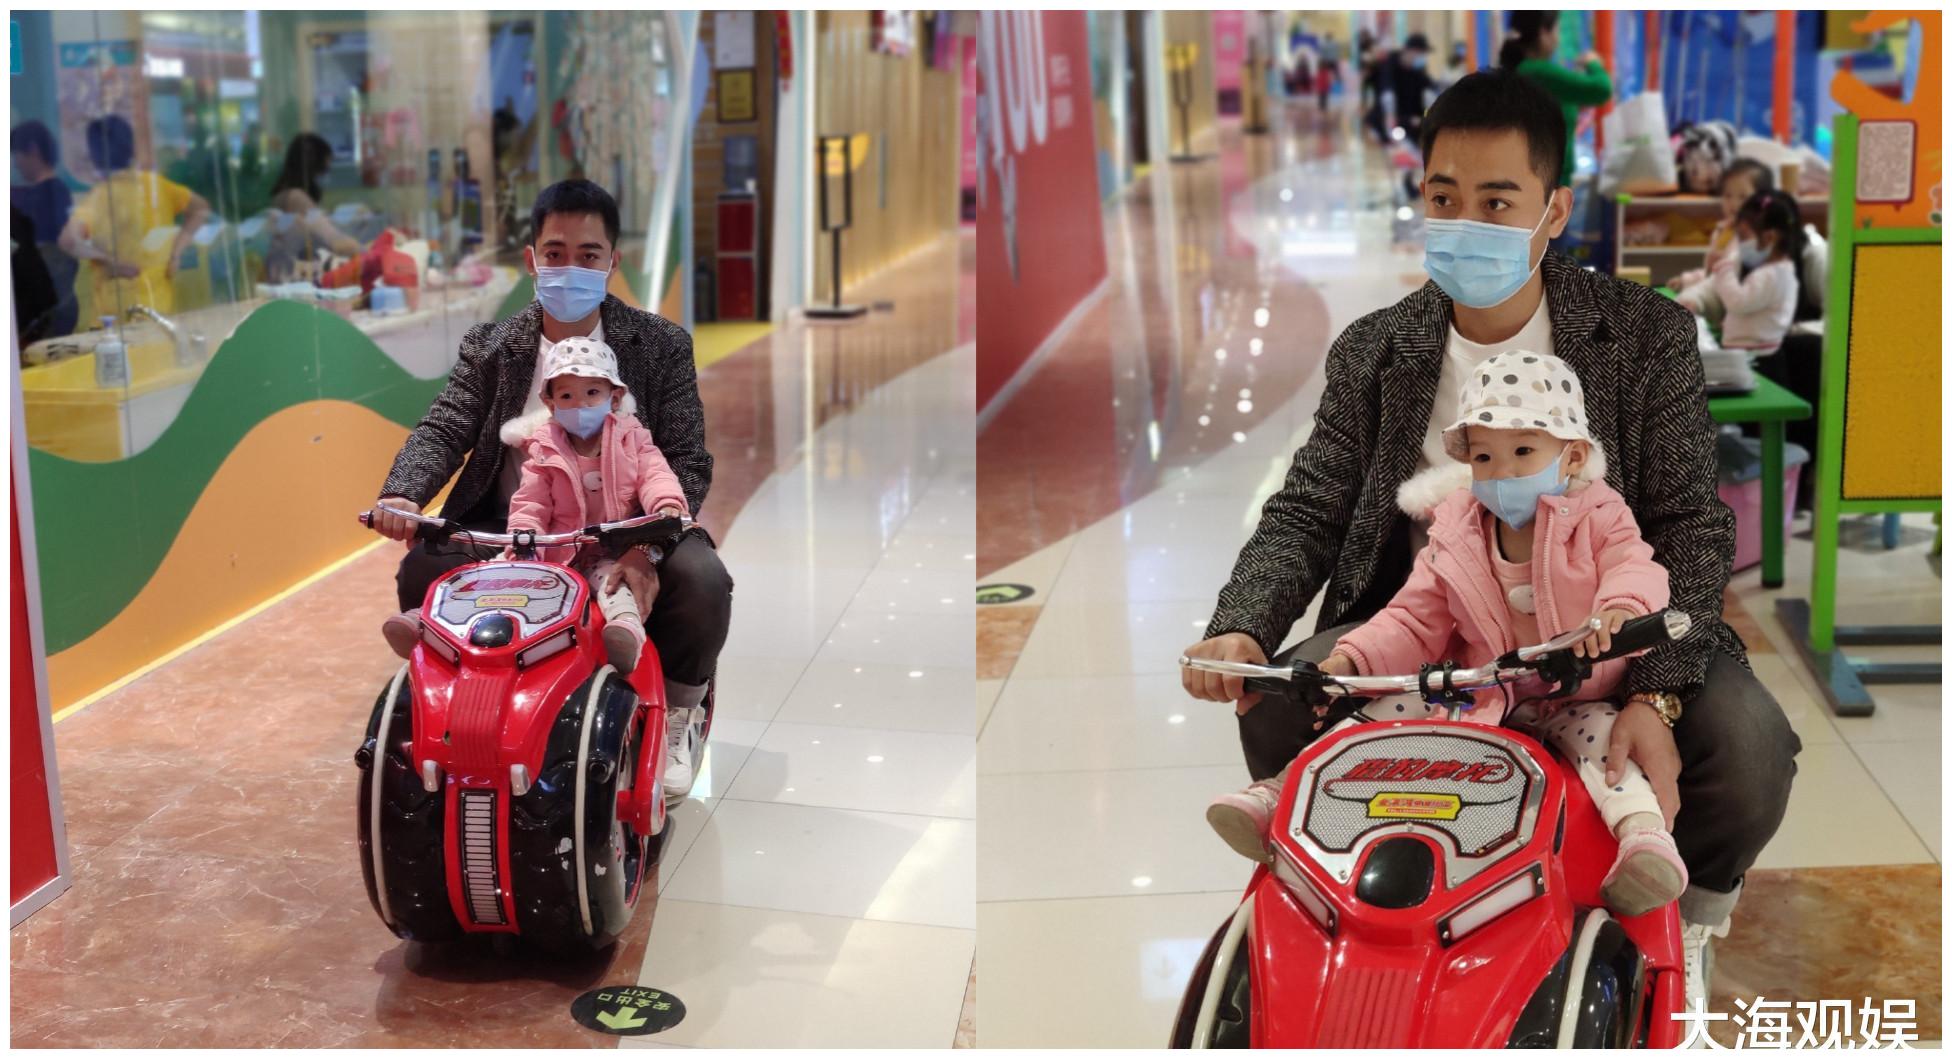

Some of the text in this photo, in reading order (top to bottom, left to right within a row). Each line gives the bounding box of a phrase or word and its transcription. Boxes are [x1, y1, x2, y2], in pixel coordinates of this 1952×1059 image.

[619, 988, 661, 999] EXIT
[598, 993, 671, 1010] 安全出口
